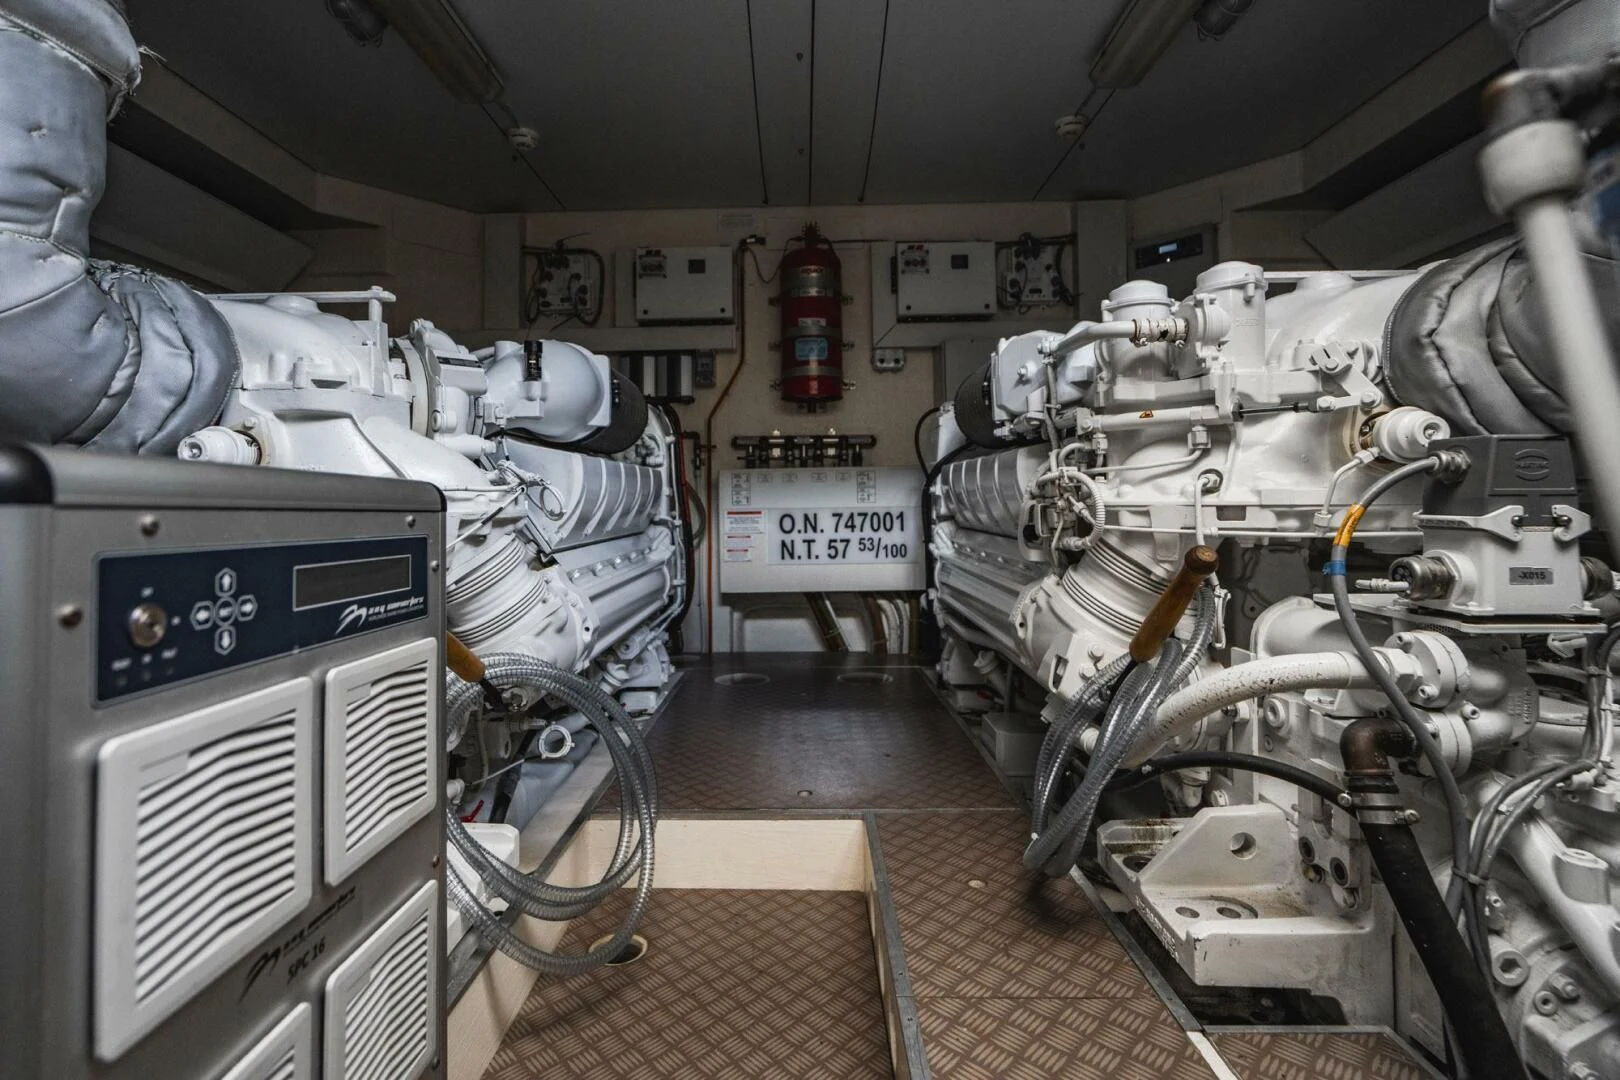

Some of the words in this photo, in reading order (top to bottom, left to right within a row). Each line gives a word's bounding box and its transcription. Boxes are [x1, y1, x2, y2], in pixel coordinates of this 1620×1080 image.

[779, 513, 824, 534] O.N.
[832, 511, 905, 533] 747001
[780, 539, 819, 560] N.T.
[827, 538, 851, 560] 57
